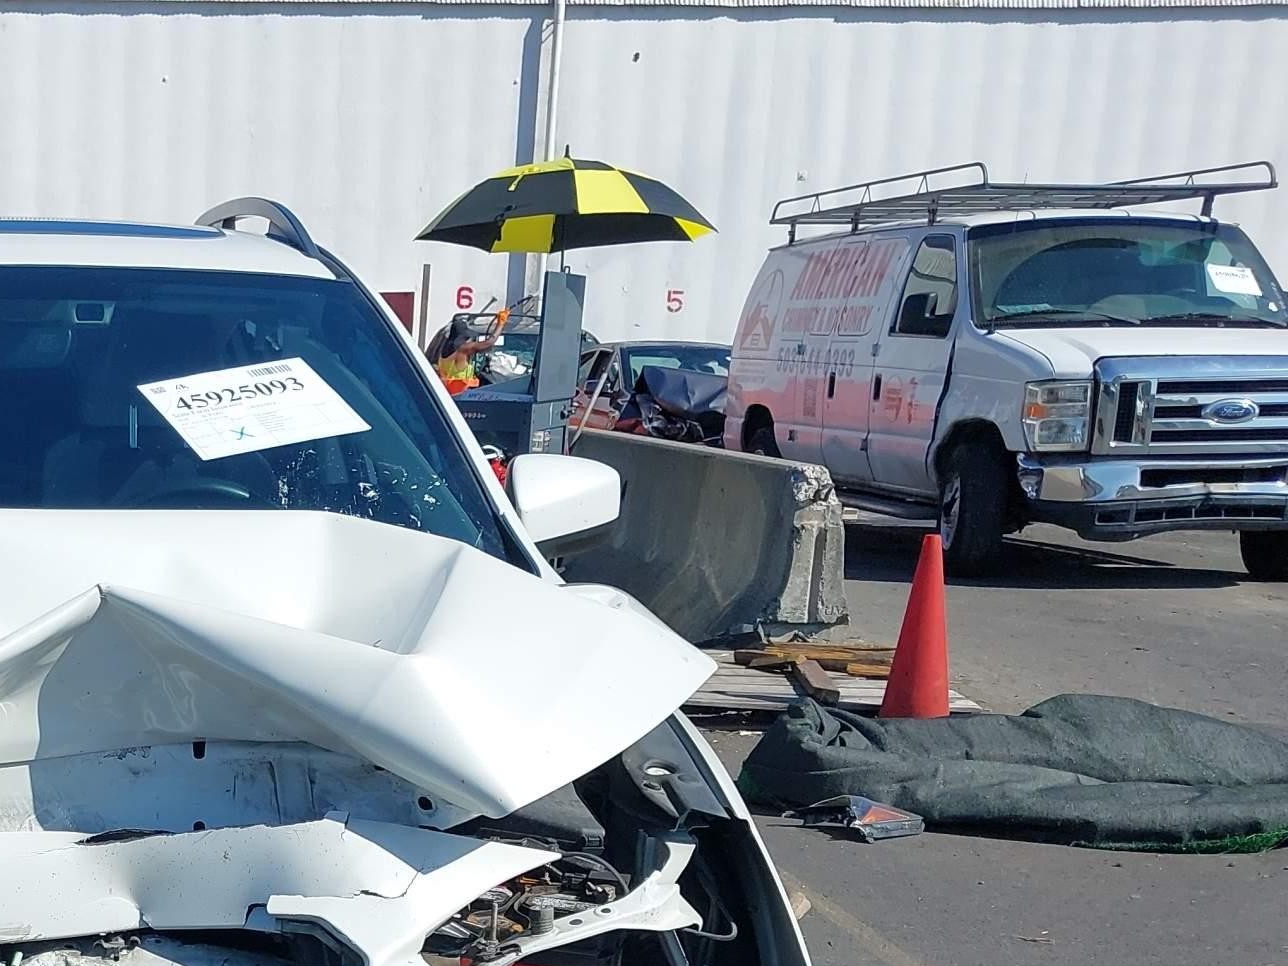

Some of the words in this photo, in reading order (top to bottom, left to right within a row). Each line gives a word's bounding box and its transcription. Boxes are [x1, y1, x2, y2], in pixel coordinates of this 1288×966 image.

[790, 242, 898, 300] AMERICAN
[456, 286, 473, 310] 6
[667, 290, 684, 312] 5
[176, 377, 305, 410] 45925093
